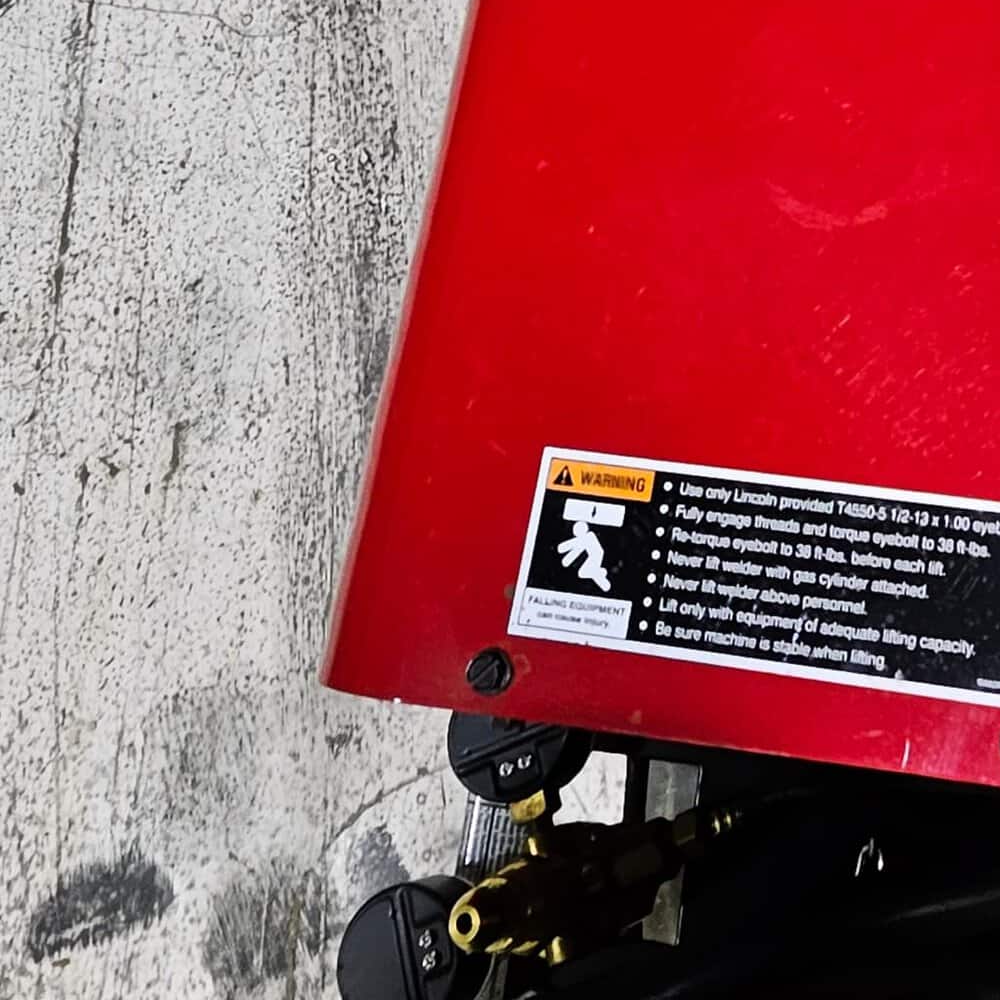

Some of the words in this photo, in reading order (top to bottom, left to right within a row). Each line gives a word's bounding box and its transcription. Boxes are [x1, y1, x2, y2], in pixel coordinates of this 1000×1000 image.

[580, 470, 645, 493] WARNING
[679, 481, 703, 498] Use
[705, 486, 732, 504] only
[733, 488, 777, 507] Lincoln
[779, 495, 833, 514] provided
[891, 507, 929, 527] 1/2-13
[931, 515, 940, 527] x
[943, 515, 970, 531] 1.00
[671, 527, 731, 549] Re-torque
[732, 538, 778, 554] eyebolt
[780, 542, 793, 557] to
[813, 545, 848, 564] ft-lbs.
[851, 550, 892, 570] before
[893, 557, 925, 574] each
[928, 560, 946, 577] lift.
[675, 504, 704, 524] Fully
[706, 510, 751, 529] engage
[754, 515, 800, 534] threads
[802, 522, 827, 537] and
[829, 524, 870, 544] torque
[872, 531, 919, 549] eyebolt
[921, 536, 935, 551] to
[956, 540, 991, 559] ft-lbs.
[663, 573, 700, 592] Never
[701, 579, 717, 594] lift
[717, 583, 760, 600] welder
[759, 588, 800, 606] above
[802, 595, 868, 615] personnel.
[667, 550, 704, 565] Never
[705, 555, 721, 571] lift
[722, 560, 763, 577] welder
[765, 565, 791, 580] with
[793, 570, 816, 586] gas
[818, 572, 869, 592] cylinder
[871, 579, 929, 599] attached.
[528, 595, 567, 609] FALLING
[569, 601, 625, 617] EQUIPMENT
[659, 597, 678, 613] Lift
[679, 602, 706, 620] only
[708, 606, 733, 621] with
[736, 609, 803, 632] equipment
[804, 618, 818, 633] of
[820, 621, 881, 642] adequate
[882, 628, 917, 651] lifting
[919, 635, 977, 659] capacity.
[655, 621, 672, 638] Be
[674, 626, 702, 642] sure
[704, 630, 756, 650] machine
[759, 635, 770, 651] is
[773, 635, 811, 658] stable
[813, 645, 848, 663] when
